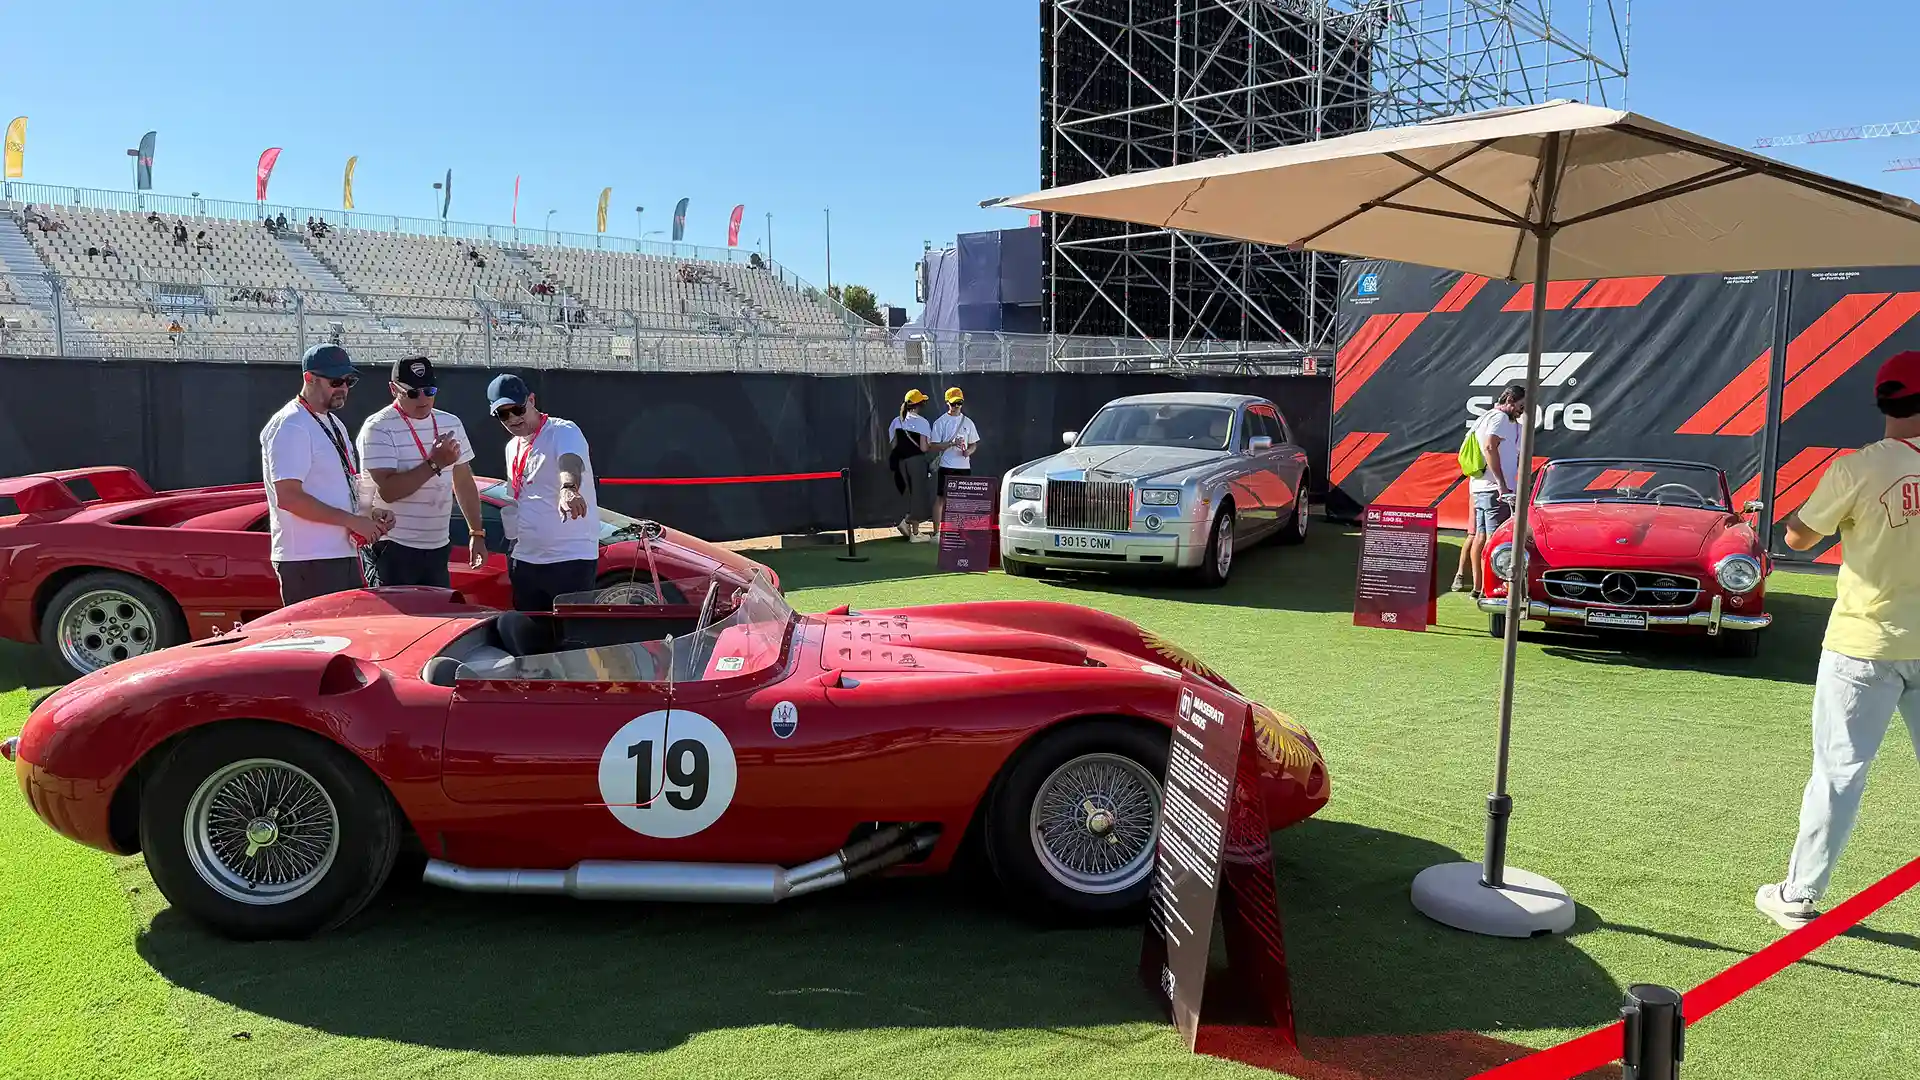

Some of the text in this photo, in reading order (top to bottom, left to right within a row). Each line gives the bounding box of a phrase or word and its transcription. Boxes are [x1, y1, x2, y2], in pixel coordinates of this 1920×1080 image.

[1465, 396, 1592, 431] Sre
[1368, 511, 1380, 520] 04
[1383, 511, 1434, 519] MERCEDES-BENZ
[1061, 536, 1111, 549] 3015 CNM
[1193, 696, 1225, 725] MASERATI
[627, 738, 710, 811] 19
